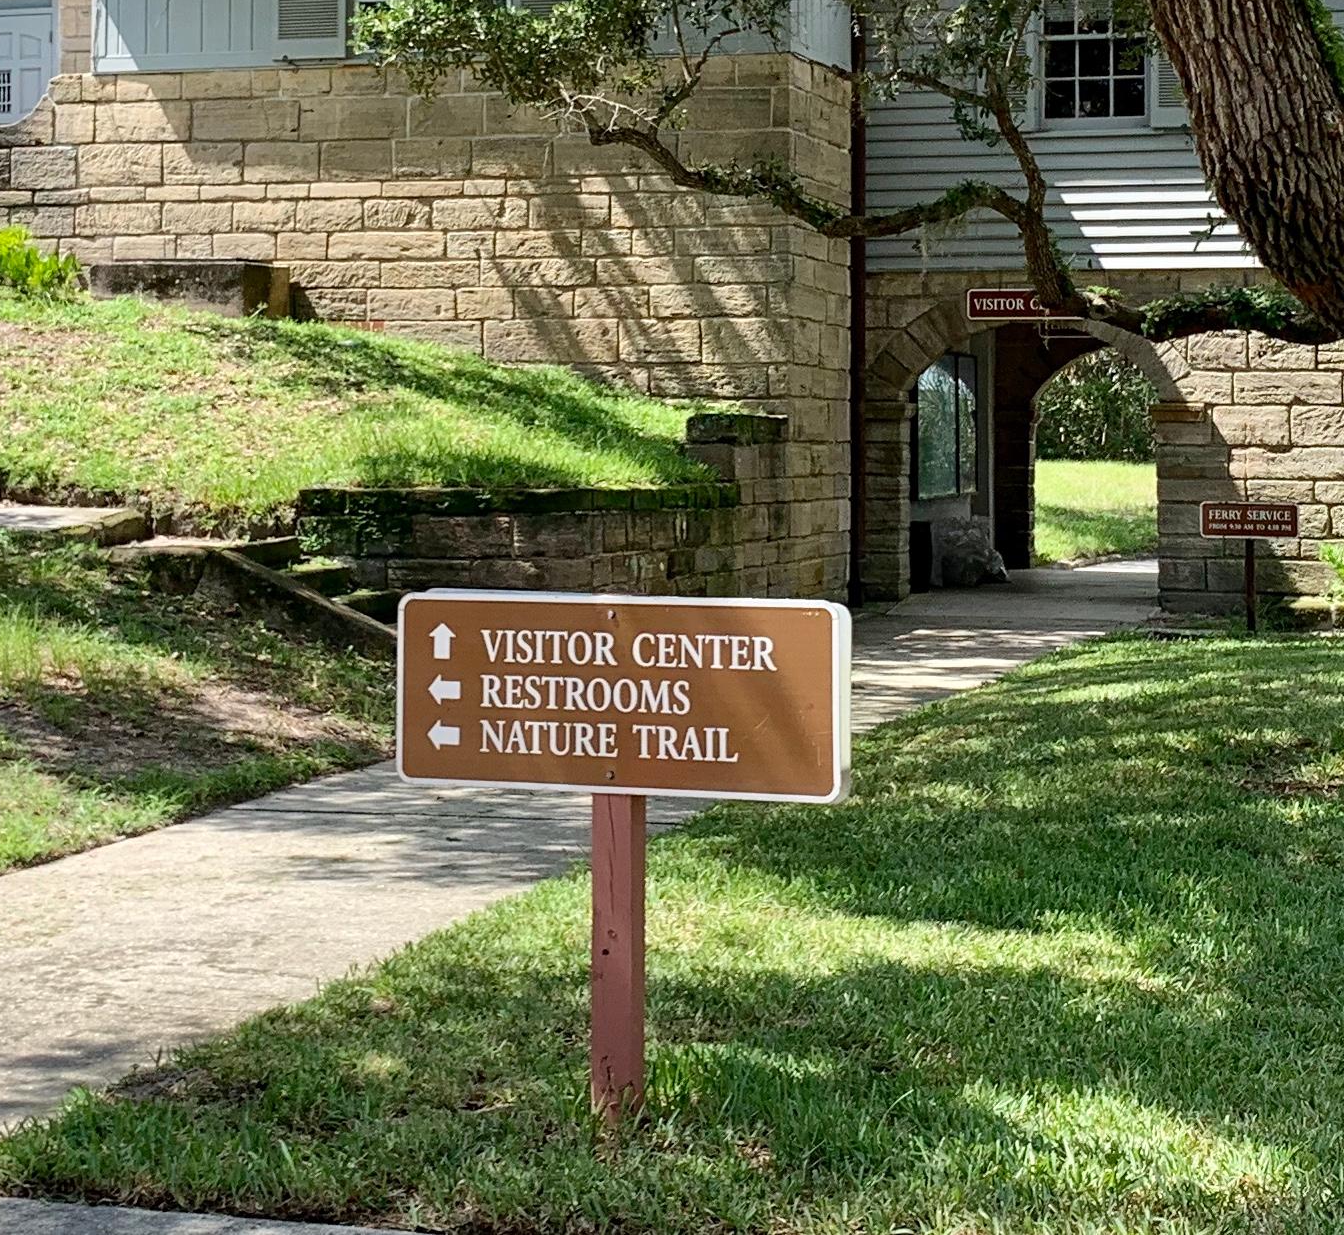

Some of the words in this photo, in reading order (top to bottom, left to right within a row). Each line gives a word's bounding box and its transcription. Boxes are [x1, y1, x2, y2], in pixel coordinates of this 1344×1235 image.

[973, 298, 1025, 311] VISITOR
[1208, 509, 1242, 520] FERRY
[1247, 510, 1291, 521] SERVICE
[480, 629, 618, 666] VISITOR
[632, 632, 778, 672] CENTER
[480, 674, 691, 715] RESTROOMS
[479, 719, 618, 758] NATURE
[632, 724, 739, 763] TRAIL
